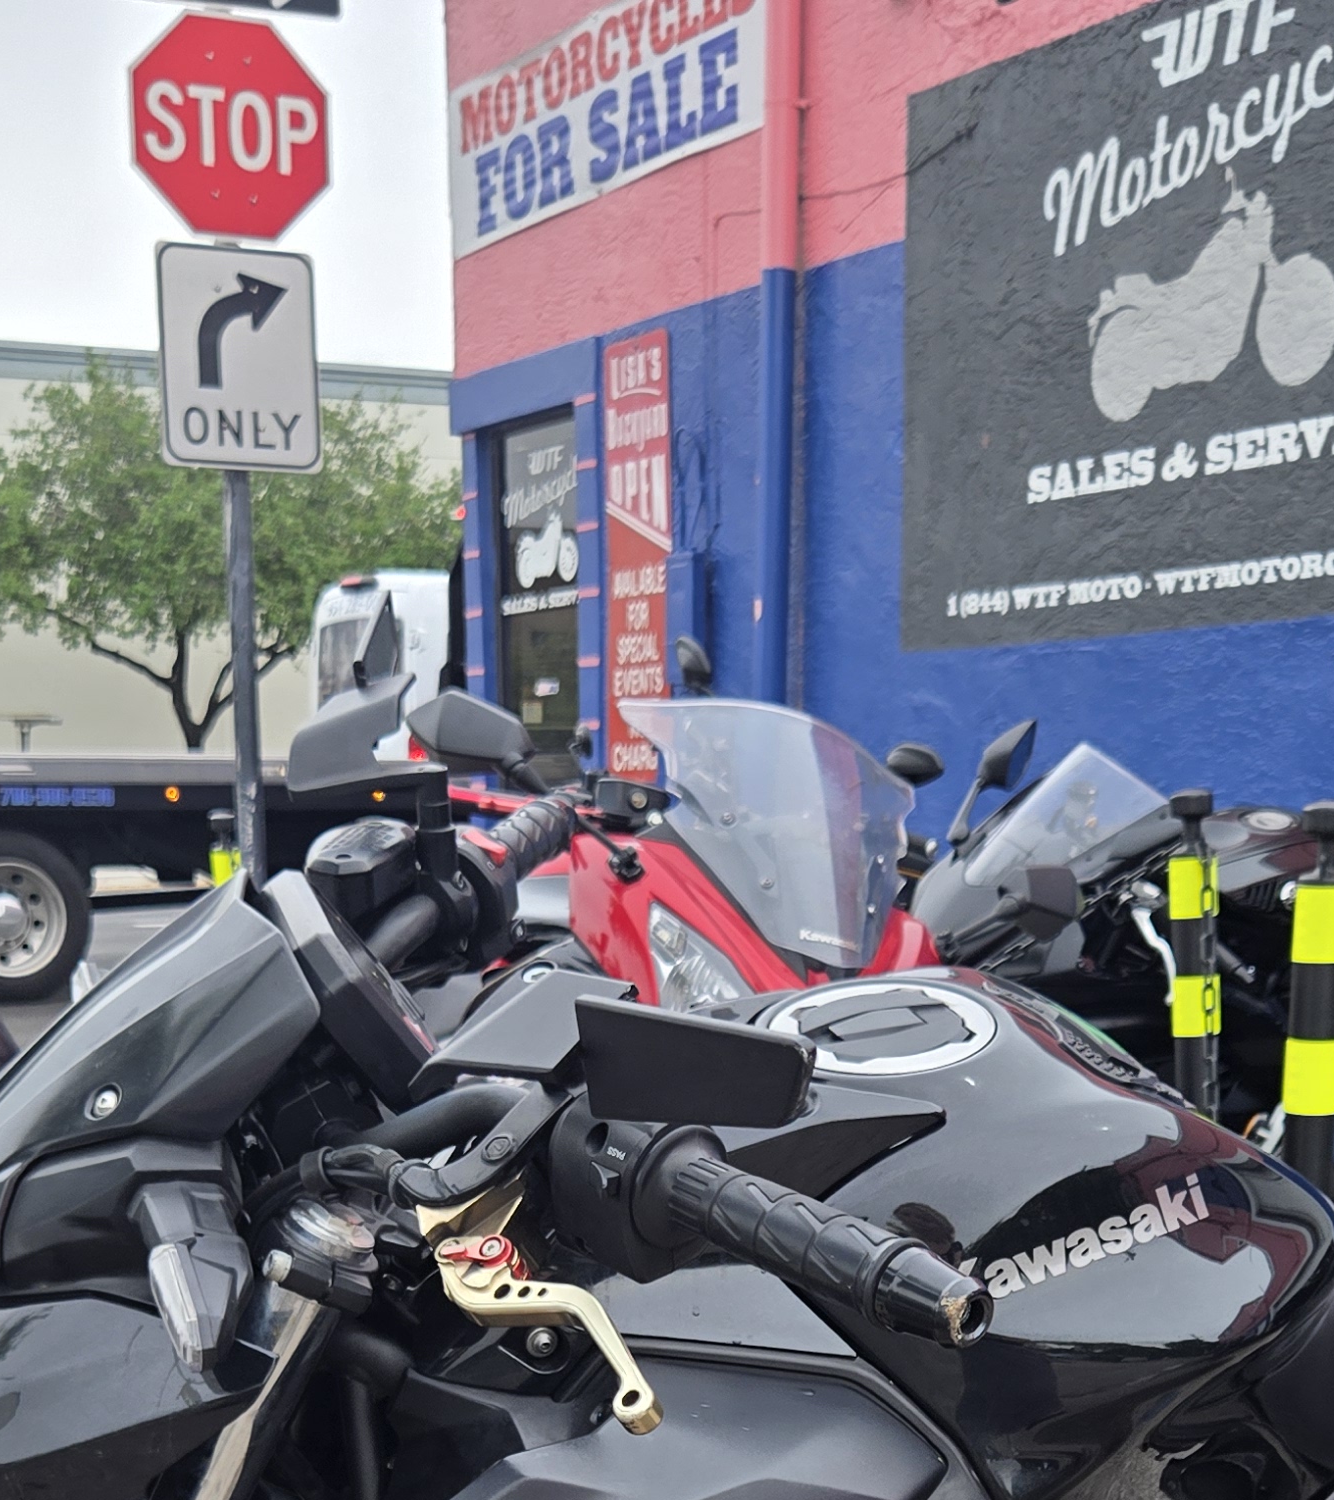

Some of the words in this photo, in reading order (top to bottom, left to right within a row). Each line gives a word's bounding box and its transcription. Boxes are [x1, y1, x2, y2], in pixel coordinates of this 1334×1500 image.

[460, 0, 754, 155] MOTORCYCL
[1141, 0, 1296, 88] WTF
[143, 80, 319, 176] STOP
[475, 115, 575, 238] FOR
[588, 26, 739, 184] SALE
[183, 406, 301, 452] ONLY
[610, 452, 667, 532] OPEN
[1027, 447, 1156, 504] SALES
[1161, 442, 1199, 482] &
[1012, 584, 1066, 611] WTF
[1067, 574, 1143, 606] MOTO
[612, 664, 664, 698] EVENTS
